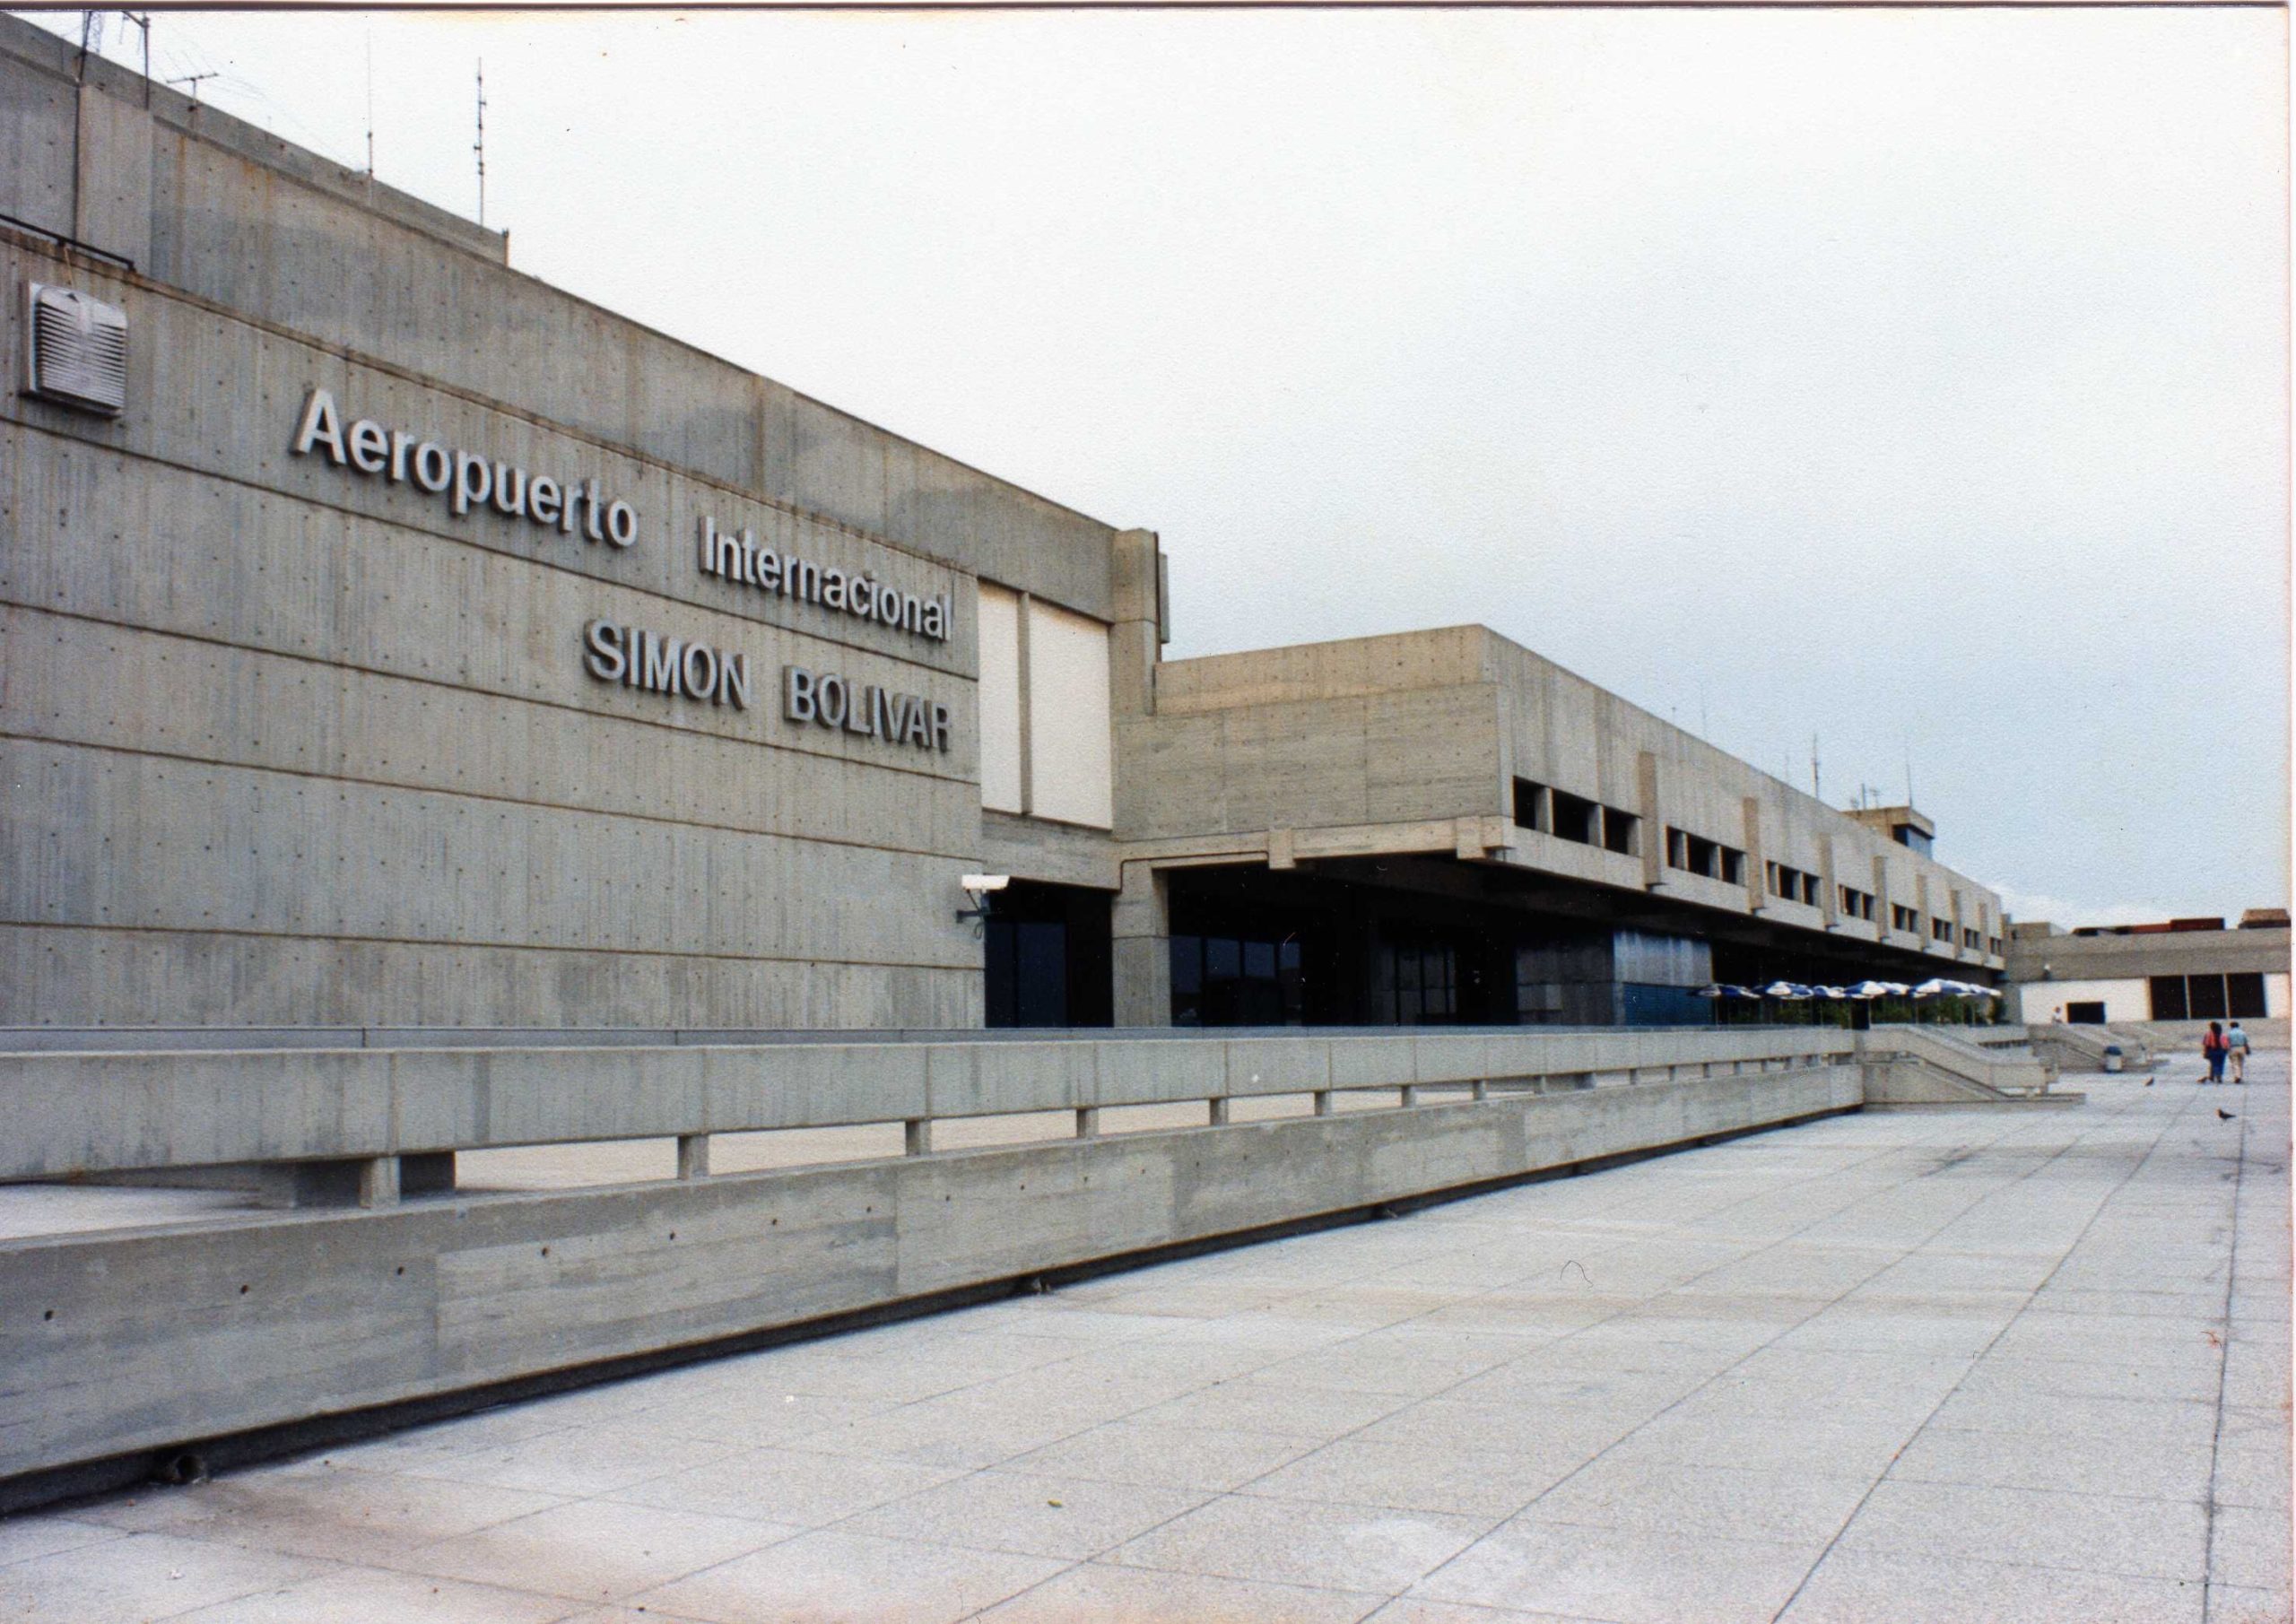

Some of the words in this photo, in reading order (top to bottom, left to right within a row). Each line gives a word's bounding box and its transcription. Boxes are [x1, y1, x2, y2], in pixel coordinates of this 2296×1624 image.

[294, 388, 638, 548] Aeropuerto
[700, 517, 952, 641] Internacional
[586, 619, 752, 709] SIMON
[786, 665, 950, 751] BOLIVAR
